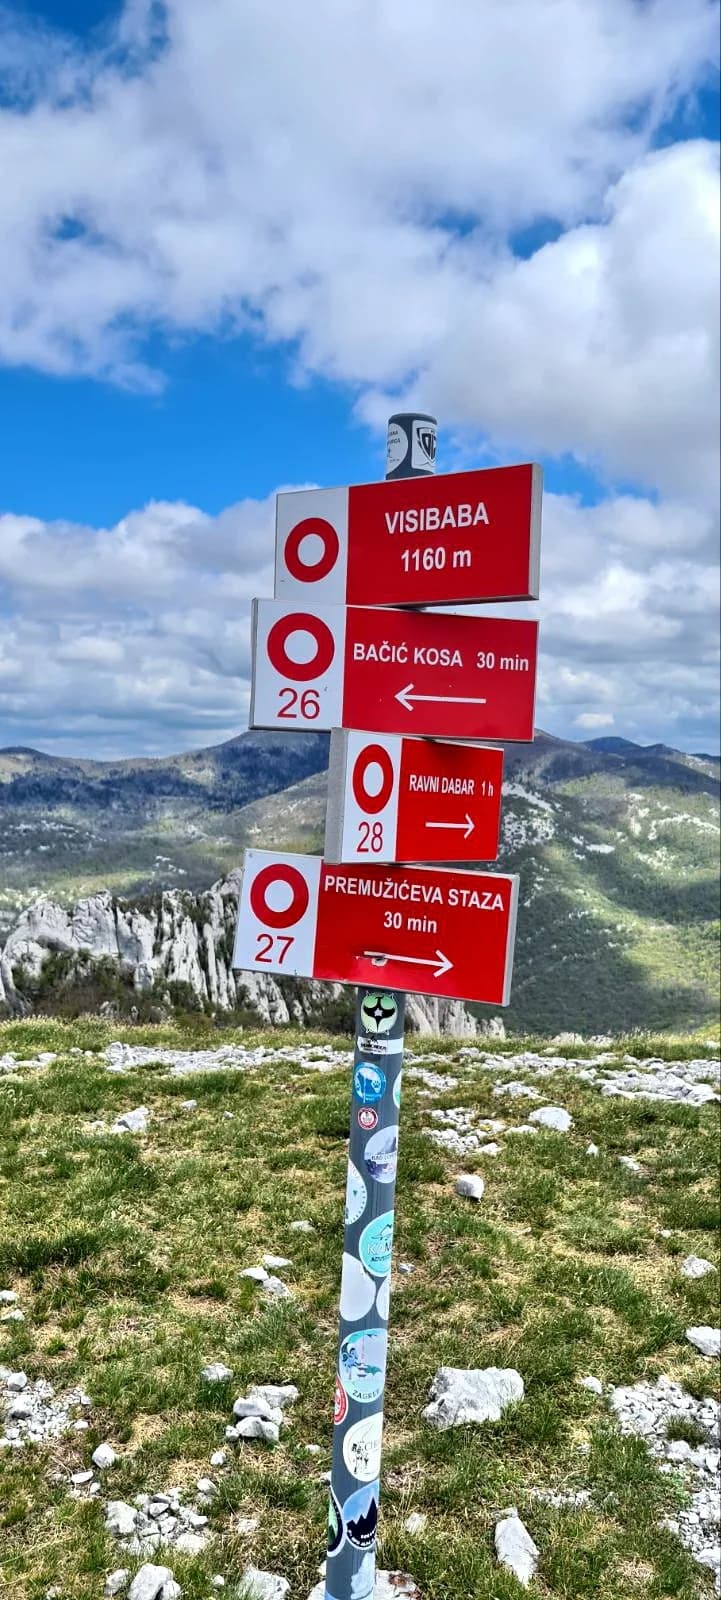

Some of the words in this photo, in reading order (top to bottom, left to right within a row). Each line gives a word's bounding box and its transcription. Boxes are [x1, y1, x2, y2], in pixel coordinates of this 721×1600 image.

[385, 502, 490, 534] VISIBABA
[400, 547, 446, 572] 1160
[452, 549, 472, 568] m
[353, 641, 408, 663] BAČIĆ
[413, 647, 463, 667] KOSA
[476, 652, 495, 670] 30
[499, 654, 529, 672] min
[277, 687, 320, 720] 26
[409, 775, 440, 792] RAVNI
[441, 777, 475, 796] DABAR
[481, 783, 486, 797] 1
[487, 784, 494, 797] h
[356, 821, 384, 853] 28
[324, 875, 443, 906] PREMUŽIĆEVA
[447, 889, 505, 911] STAZA
[383, 911, 402, 930] 30
[407, 915, 437, 933] min
[255, 933, 295, 965] 27
